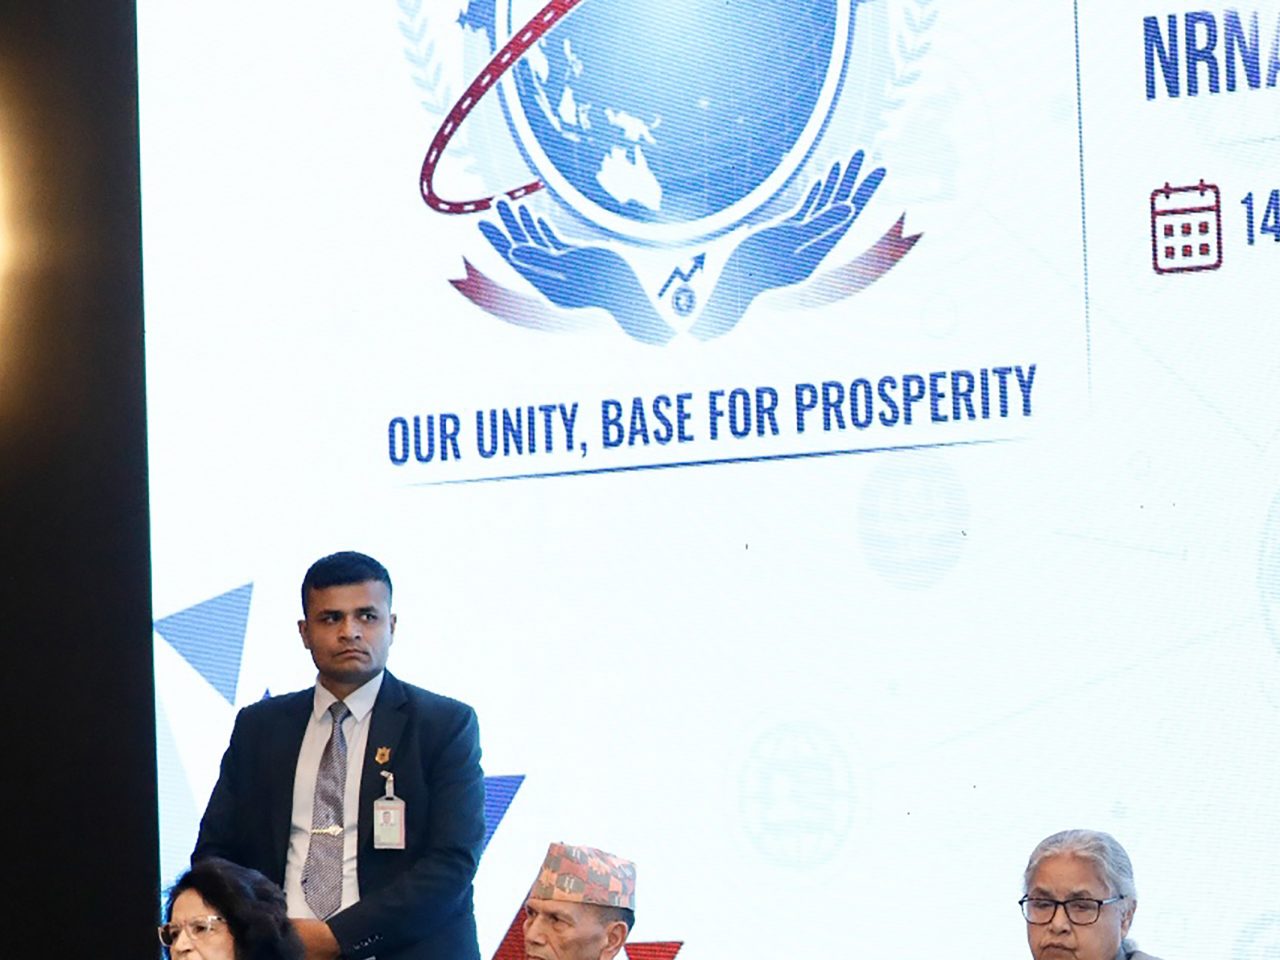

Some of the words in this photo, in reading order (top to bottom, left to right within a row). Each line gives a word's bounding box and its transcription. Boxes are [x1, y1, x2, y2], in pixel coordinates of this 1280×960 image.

[387, 412, 462, 467] OUR
[475, 402, 588, 459] UNITY,
[601, 392, 695, 450] BASE
[708, 386, 780, 441] FOR
[794, 363, 1038, 434] PROSPERITY
